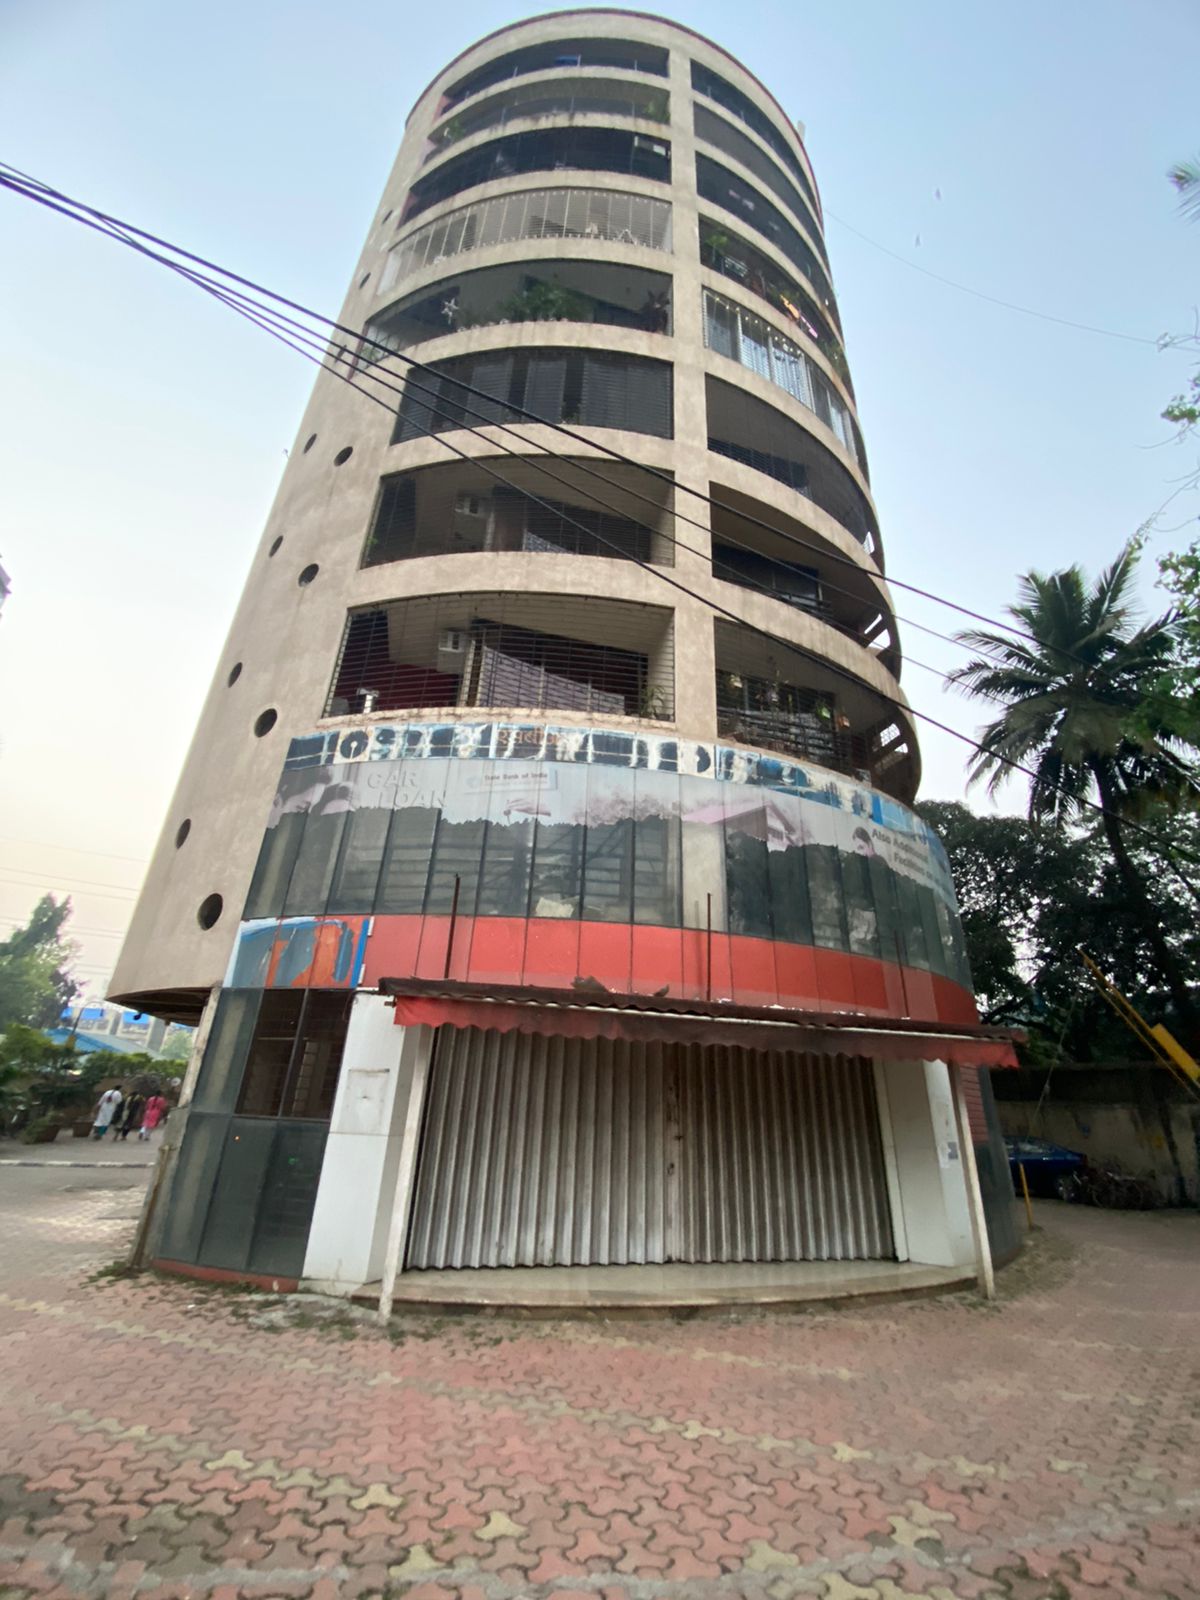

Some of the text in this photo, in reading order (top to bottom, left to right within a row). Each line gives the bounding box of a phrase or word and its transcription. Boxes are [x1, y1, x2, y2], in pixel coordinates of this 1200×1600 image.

[367, 771, 417, 789] CAR
[377, 790, 447, 808] LOAN
[872, 829, 891, 844] Also
